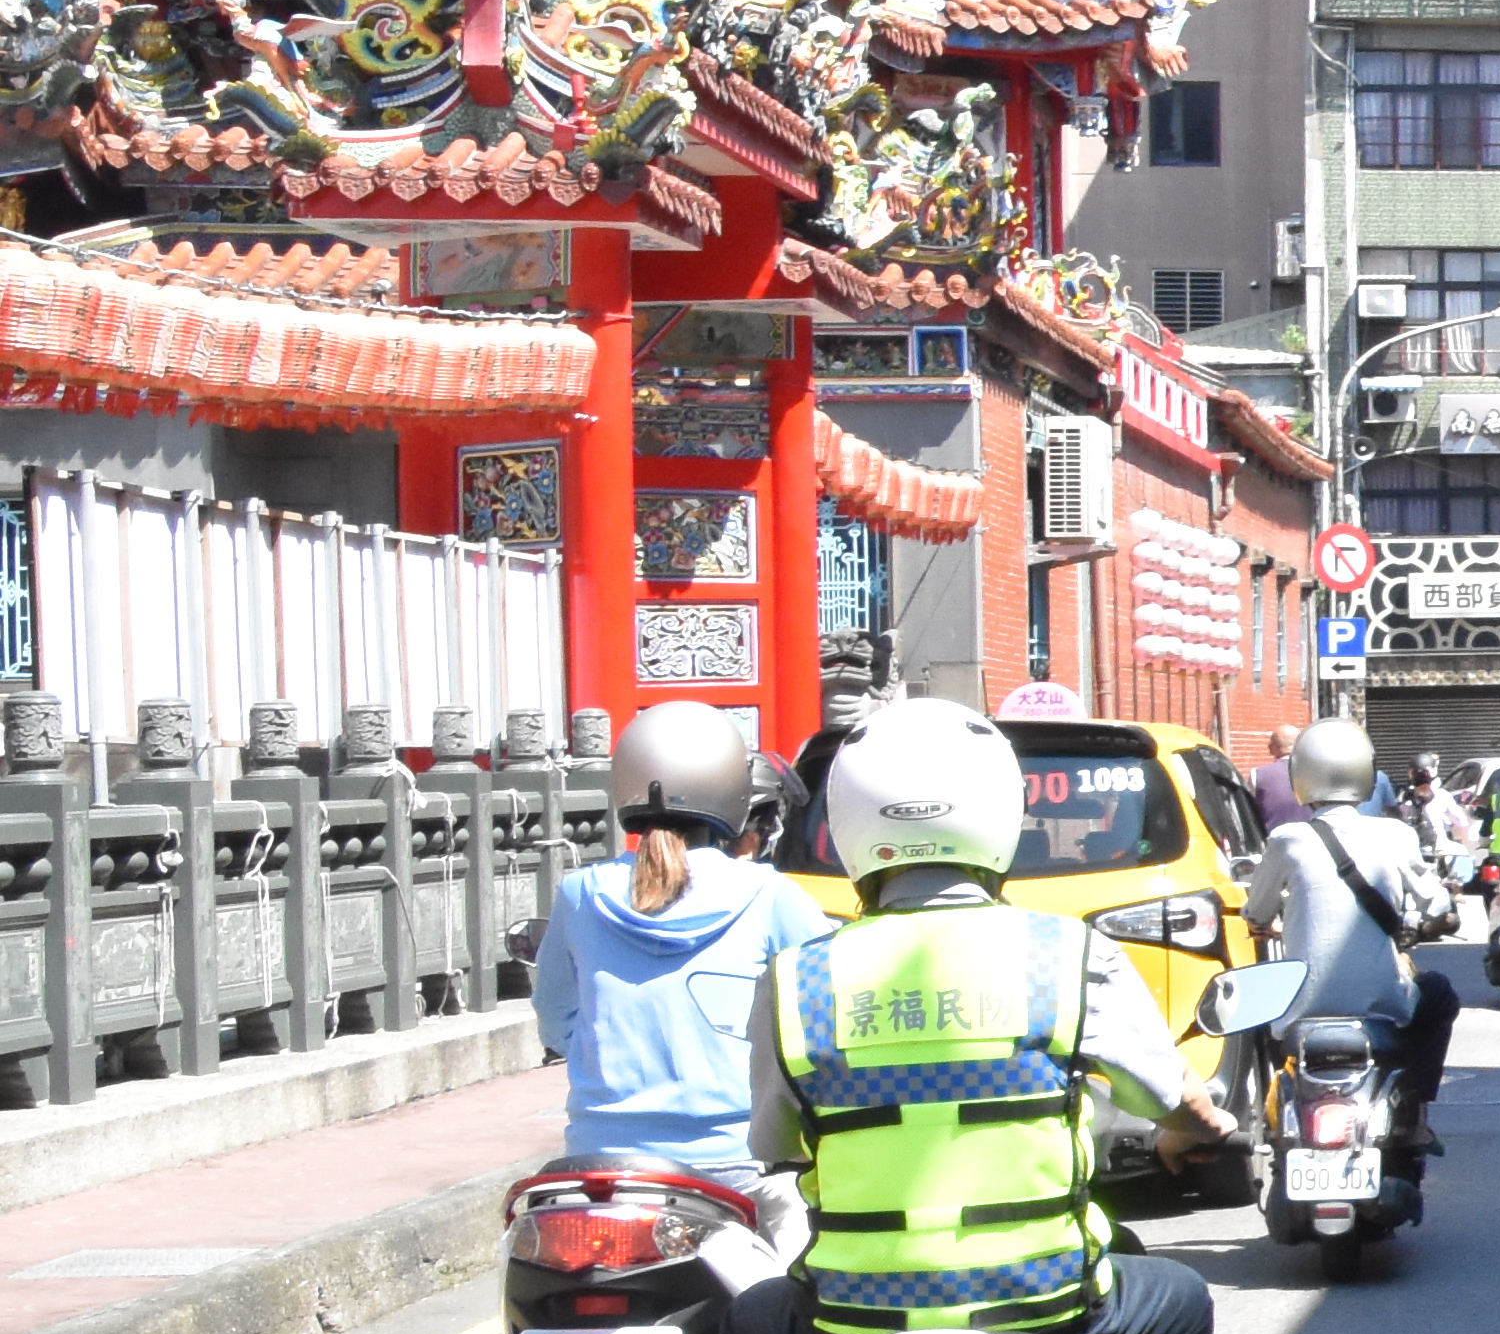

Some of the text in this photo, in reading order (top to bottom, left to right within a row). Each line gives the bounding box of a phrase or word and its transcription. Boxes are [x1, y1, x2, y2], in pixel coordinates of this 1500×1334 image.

[1328, 625, 1357, 654] P
[1018, 688, 1064, 706] 大文山
[845, 988, 1011, 1038] 景福民防
